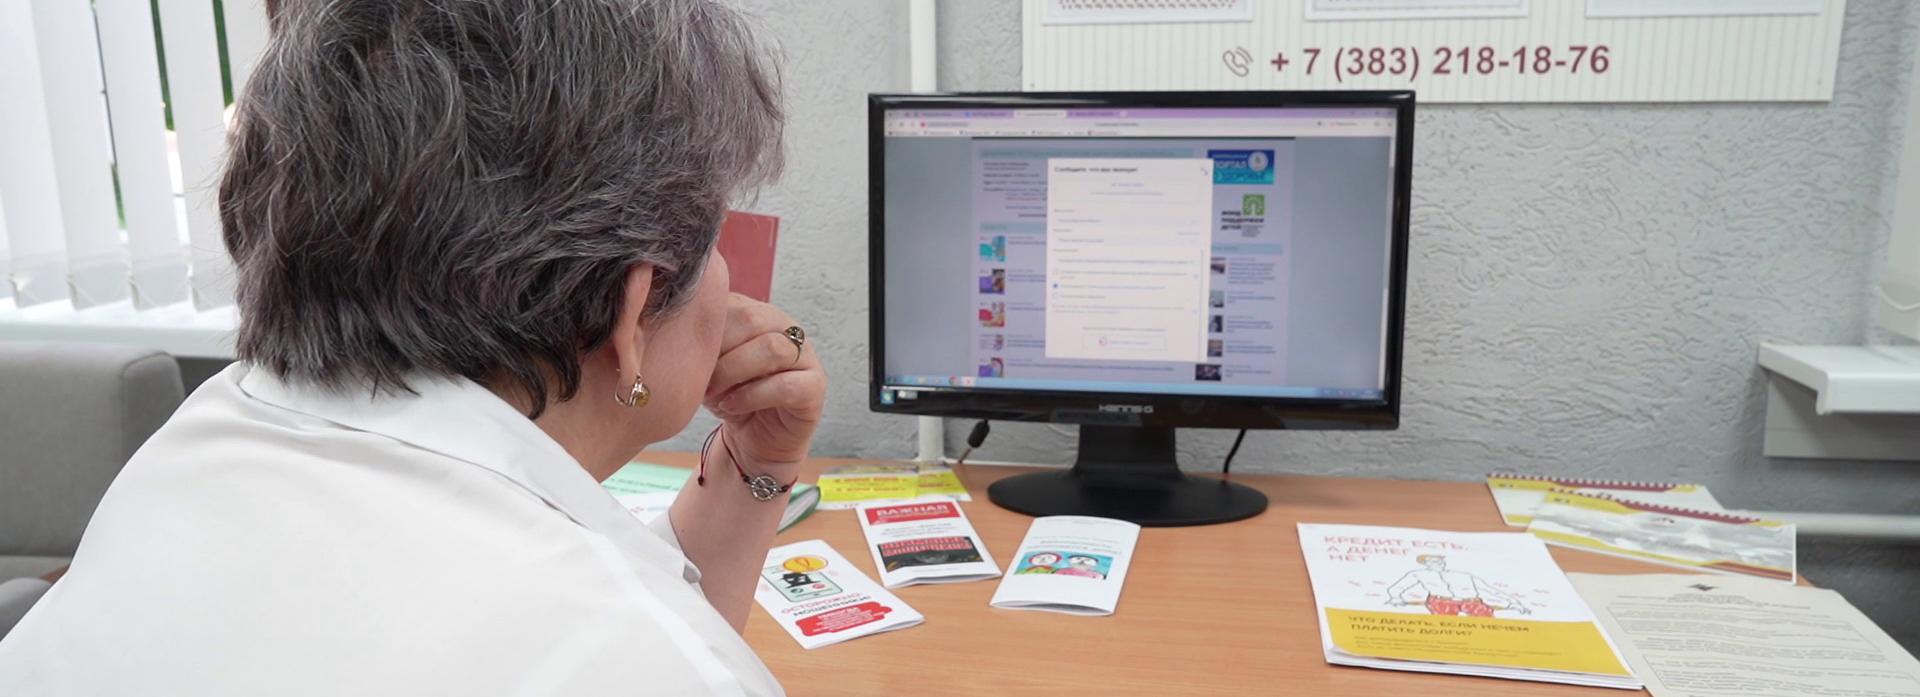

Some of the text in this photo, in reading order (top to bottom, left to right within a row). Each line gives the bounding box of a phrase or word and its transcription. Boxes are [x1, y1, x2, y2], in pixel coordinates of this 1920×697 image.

[1271, 45, 1611, 83] + 7 (383) 218-18-76
[875, 503, 949, 517] ВАЖНАЯ
[1323, 535, 1405, 547] КРЕДИТ
[1346, 546, 1410, 557] ДЕНЕГ
[1328, 554, 1369, 563] НЕТ
[1347, 615, 1377, 624] ЧТО
[1439, 620, 1478, 630] ЕСЛИ
[1480, 623, 1530, 633] НЕЧЕМ
[1350, 623, 1416, 634] ПЛАТИТЬ
